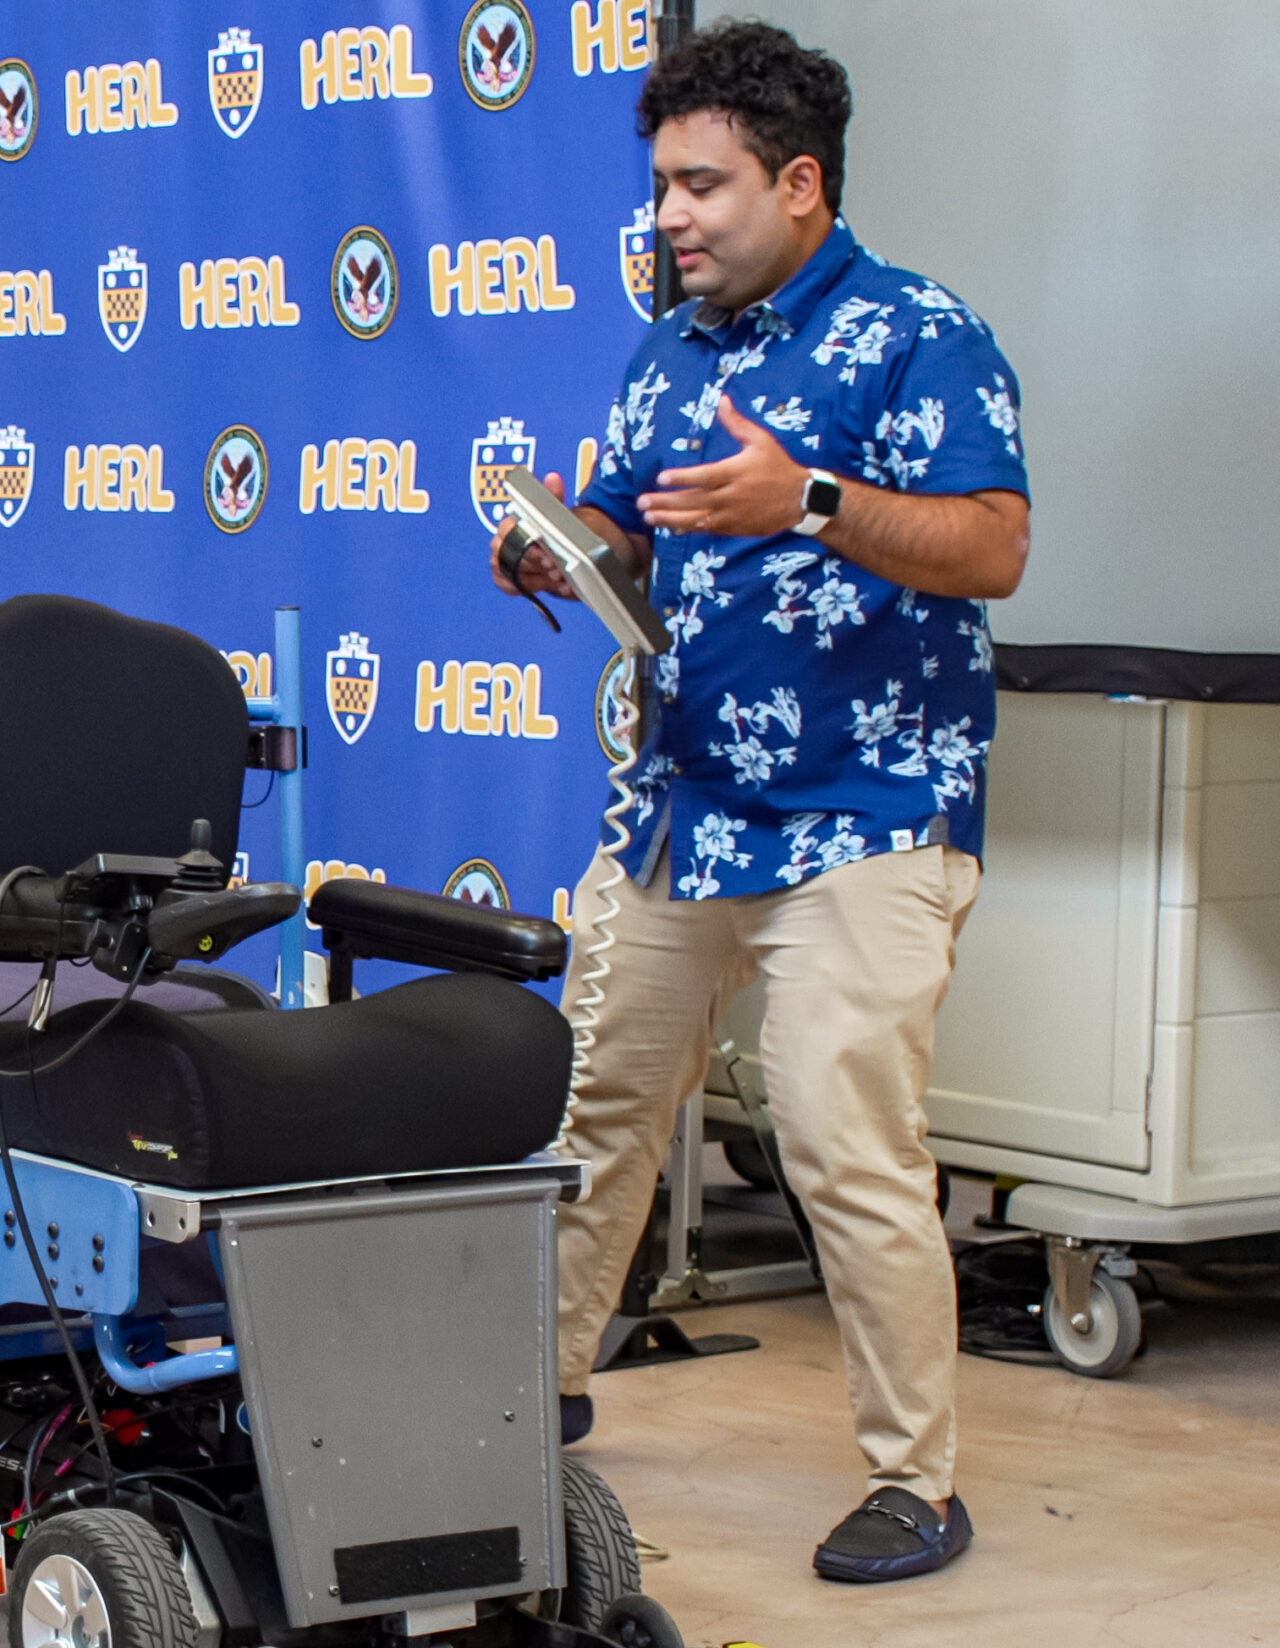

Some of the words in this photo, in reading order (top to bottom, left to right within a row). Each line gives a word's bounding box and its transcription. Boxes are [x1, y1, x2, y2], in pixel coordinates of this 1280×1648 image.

[300, 25, 433, 109] HERL
[571, 0, 658, 77] HE
[66, 59, 178, 135] HERL
[180, 256, 300, 329] HERL
[429, 235, 575, 316] HERL
[64, 444, 175, 512] HERL
[300, 438, 429, 513] HERL
[415, 661, 558, 739] HERL
